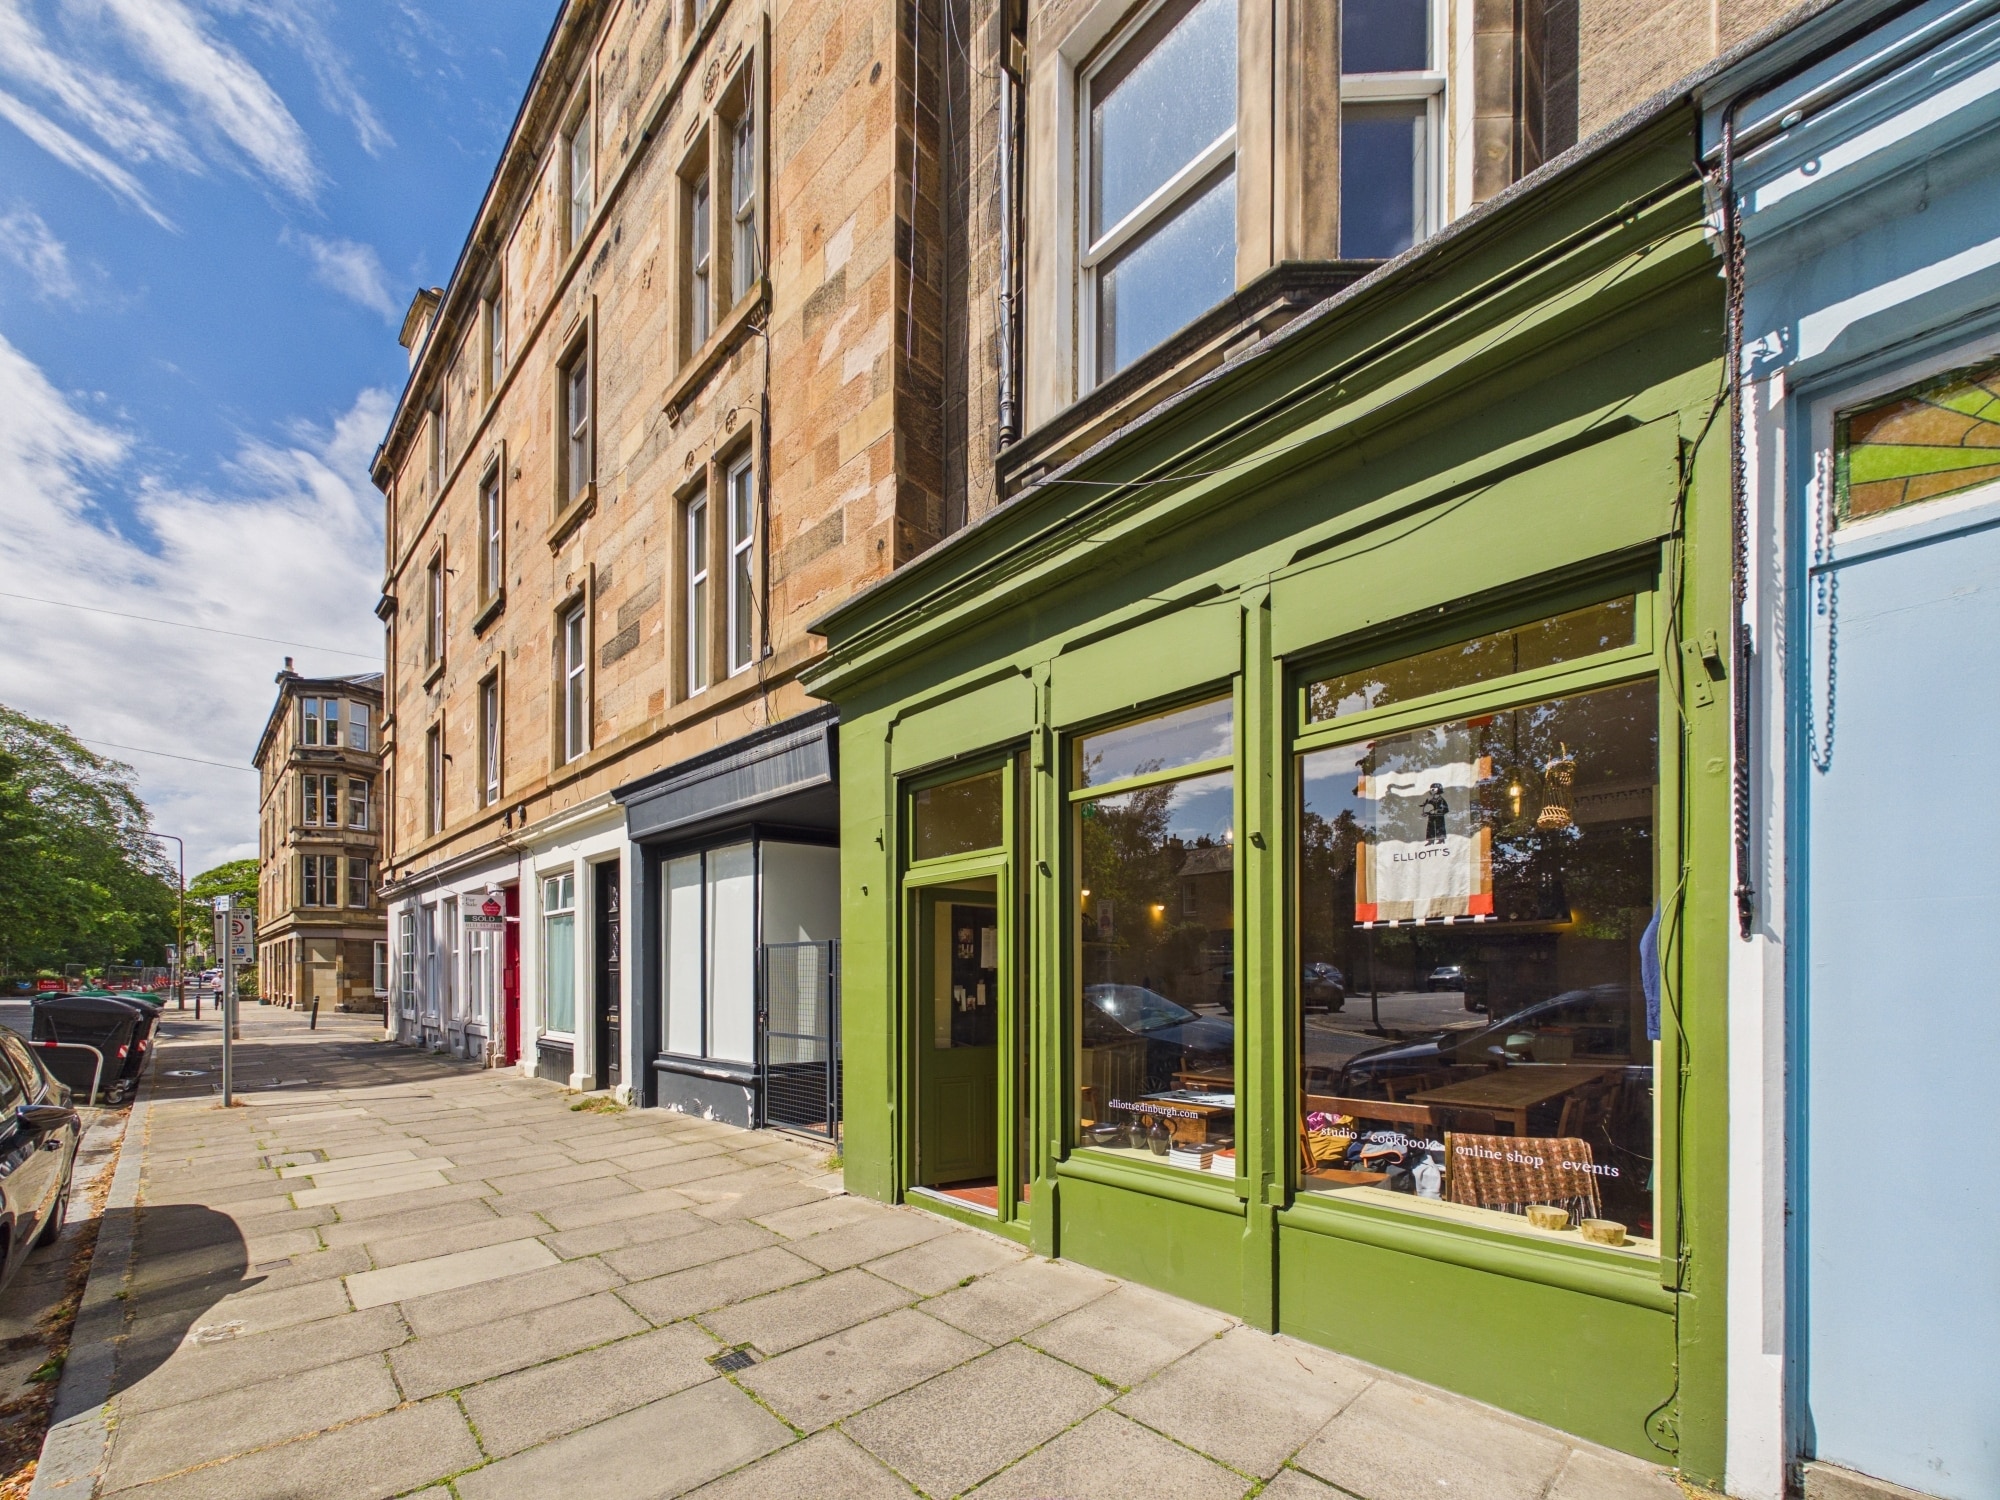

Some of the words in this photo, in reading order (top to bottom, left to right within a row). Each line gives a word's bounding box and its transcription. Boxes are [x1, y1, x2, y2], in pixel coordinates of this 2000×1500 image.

[1393, 847, 1450, 862] ELLIOTT'S
[1108, 1099, 1199, 1119] elliottsedinburgh.com
[1321, 1126, 1358, 1140] studio
[1455, 1144, 1502, 1160] online
[1506, 1150, 1544, 1169] shop
[1562, 1160, 1620, 1177] events
